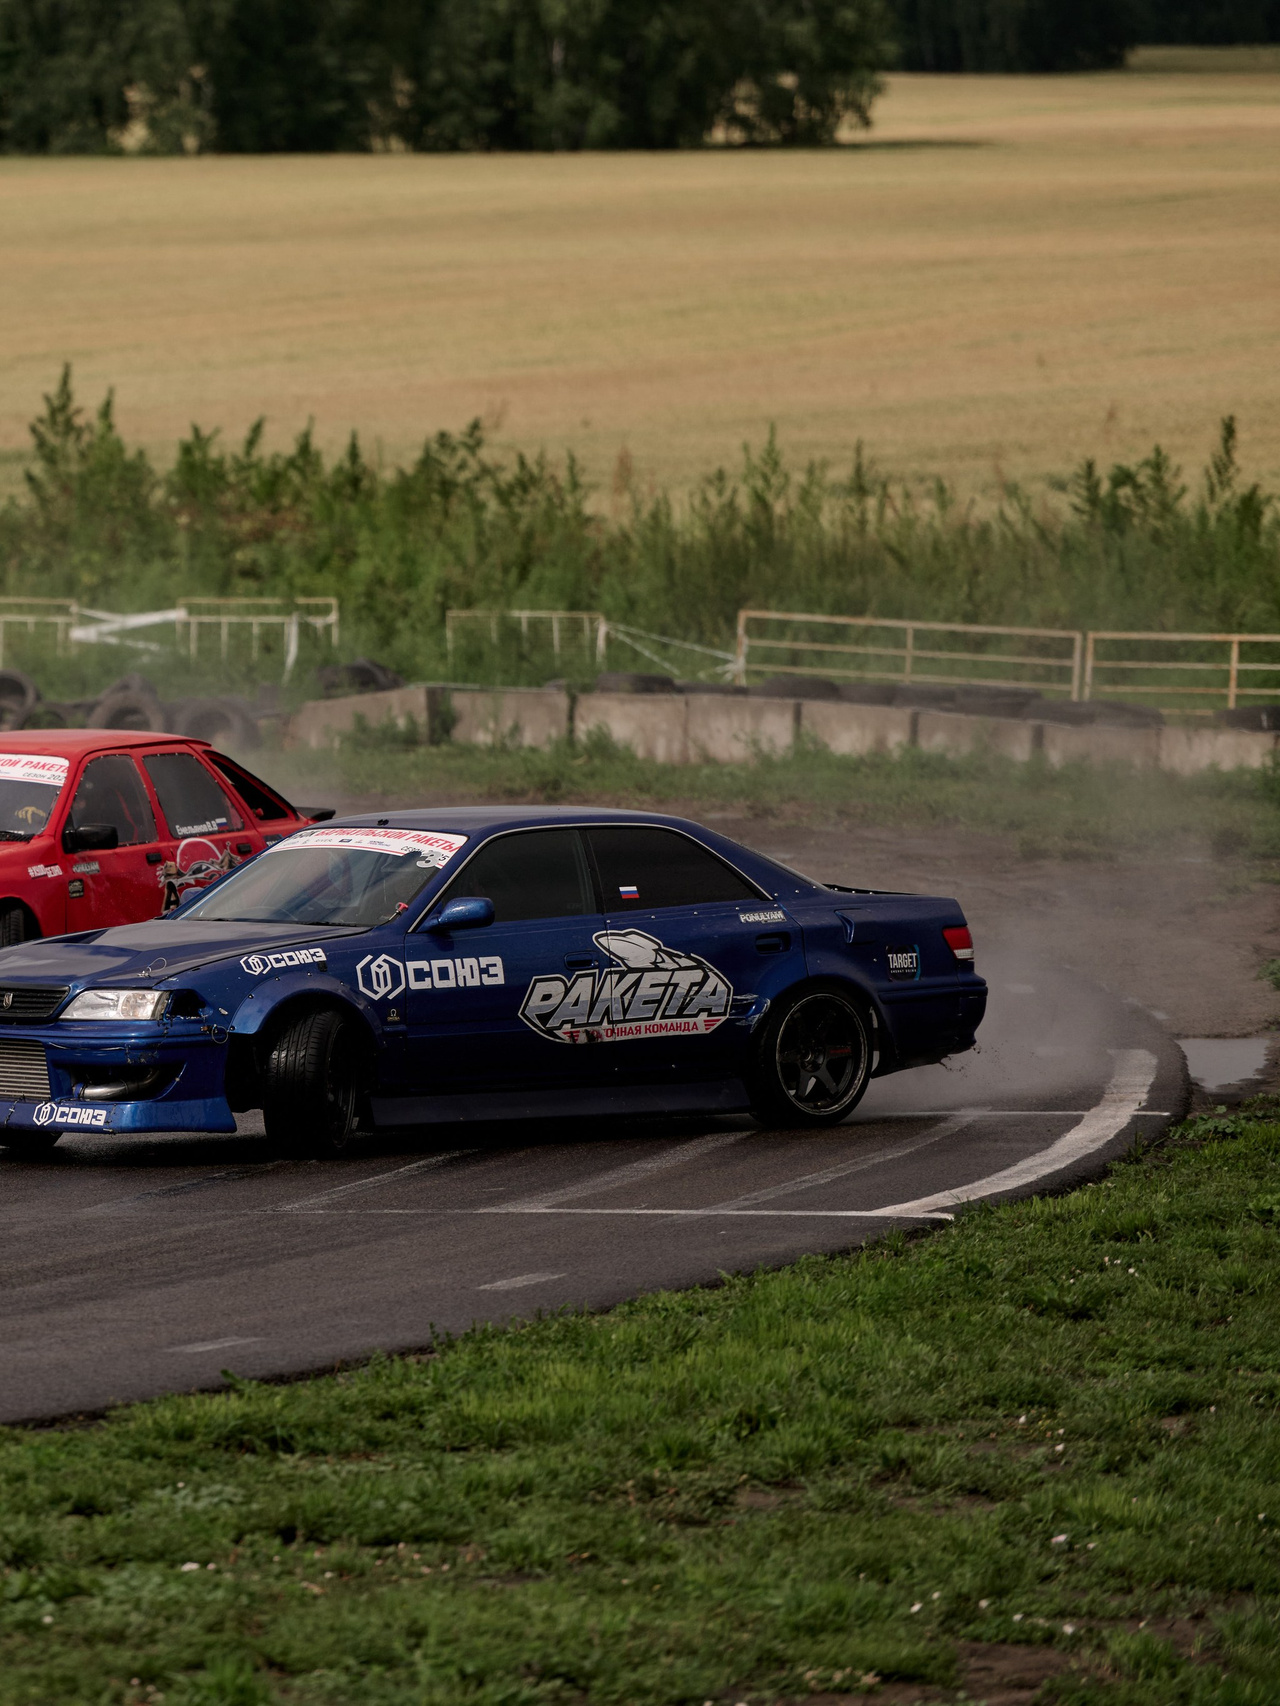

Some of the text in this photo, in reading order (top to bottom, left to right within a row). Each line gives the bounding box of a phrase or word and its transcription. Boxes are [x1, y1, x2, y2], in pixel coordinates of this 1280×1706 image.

[406, 833, 461, 853] РАКЕТЫ
[269, 948, 327, 968] СОЮЗ
[887, 953, 917, 968] TARGET
[406, 956, 505, 990] СОЮЗ
[644, 1021, 699, 1034] КОМАНДА
[55, 1107, 107, 1126] СОЮЗ
